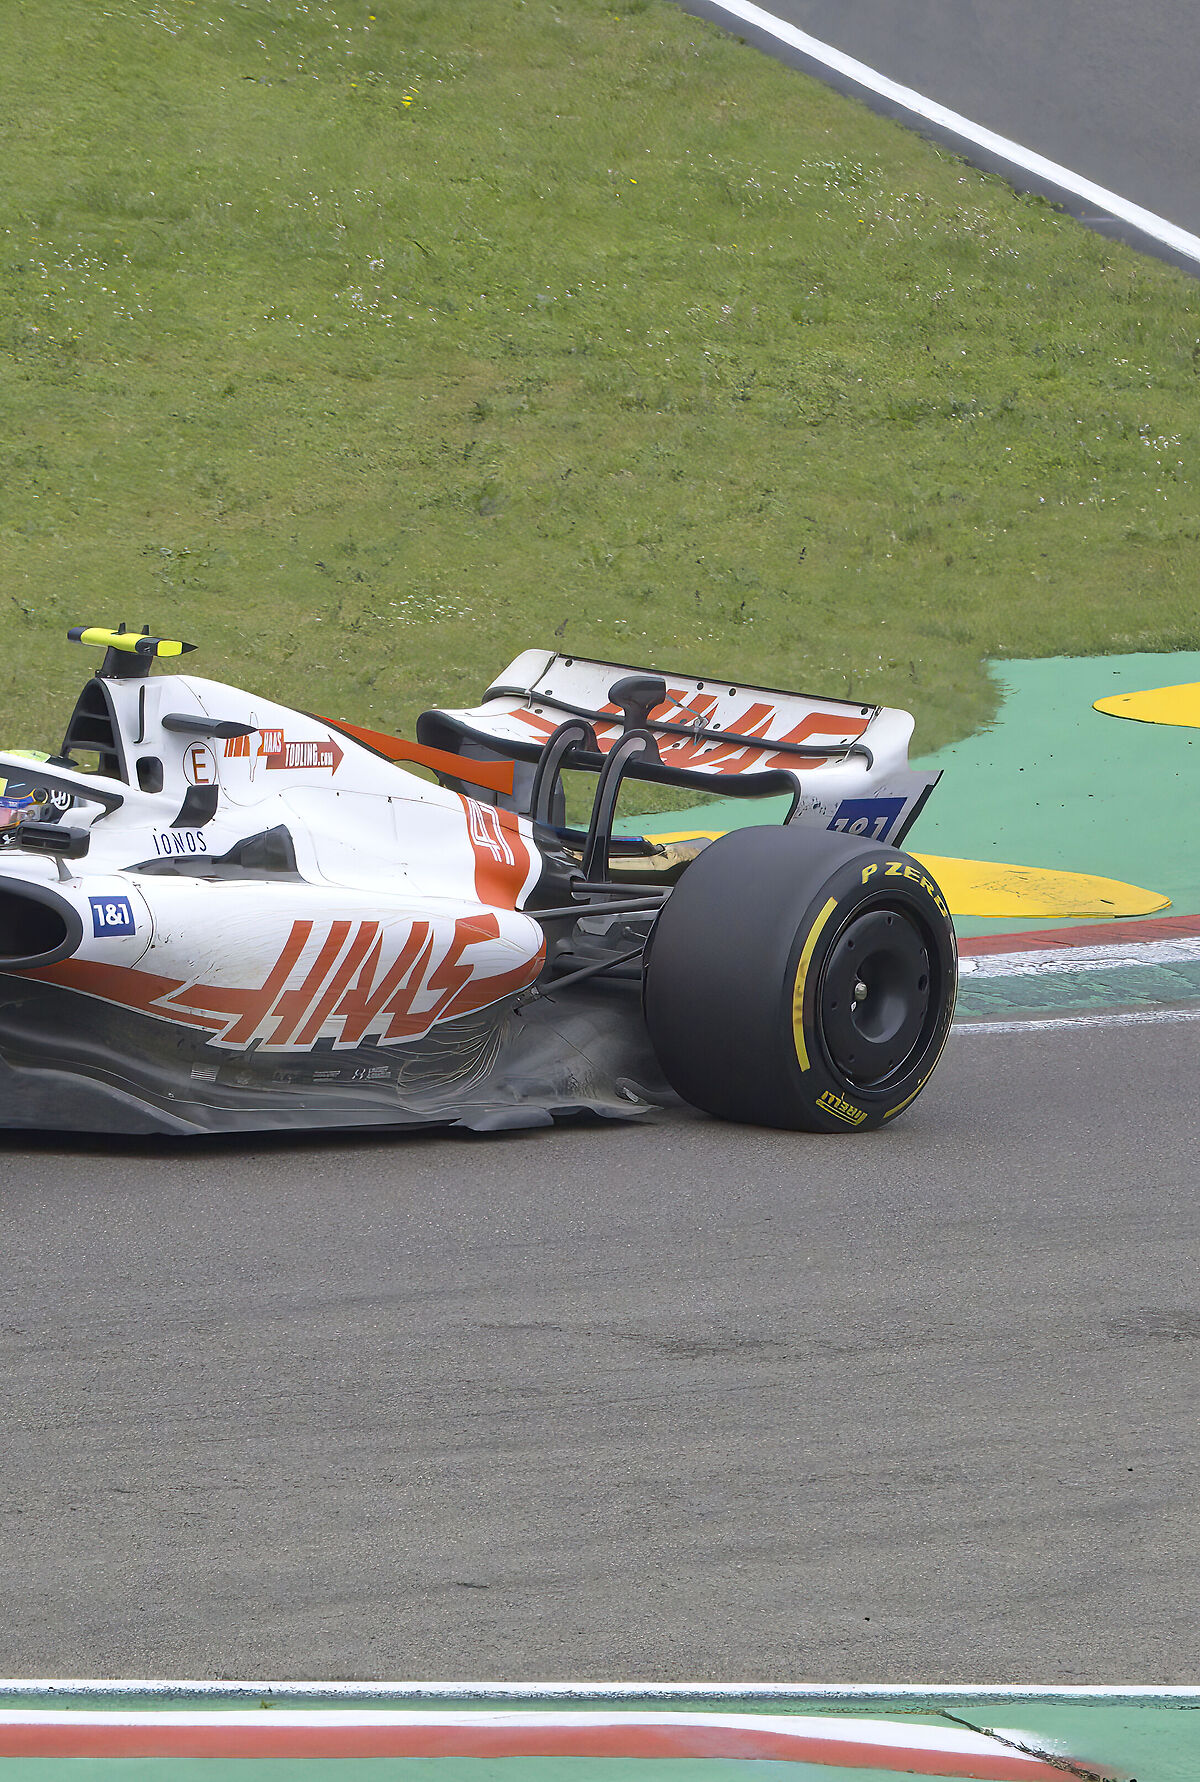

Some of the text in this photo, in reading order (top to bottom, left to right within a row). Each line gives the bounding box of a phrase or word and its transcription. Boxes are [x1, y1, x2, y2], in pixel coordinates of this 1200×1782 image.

[263, 732, 282, 753] HAAS
[191, 748, 209, 784] E
[861, 861, 949, 918] P ZERO
[93, 903, 130, 927] 1&1
[208, 911, 501, 1047] HAAS
[815, 1090, 869, 1127] PIRELLI
